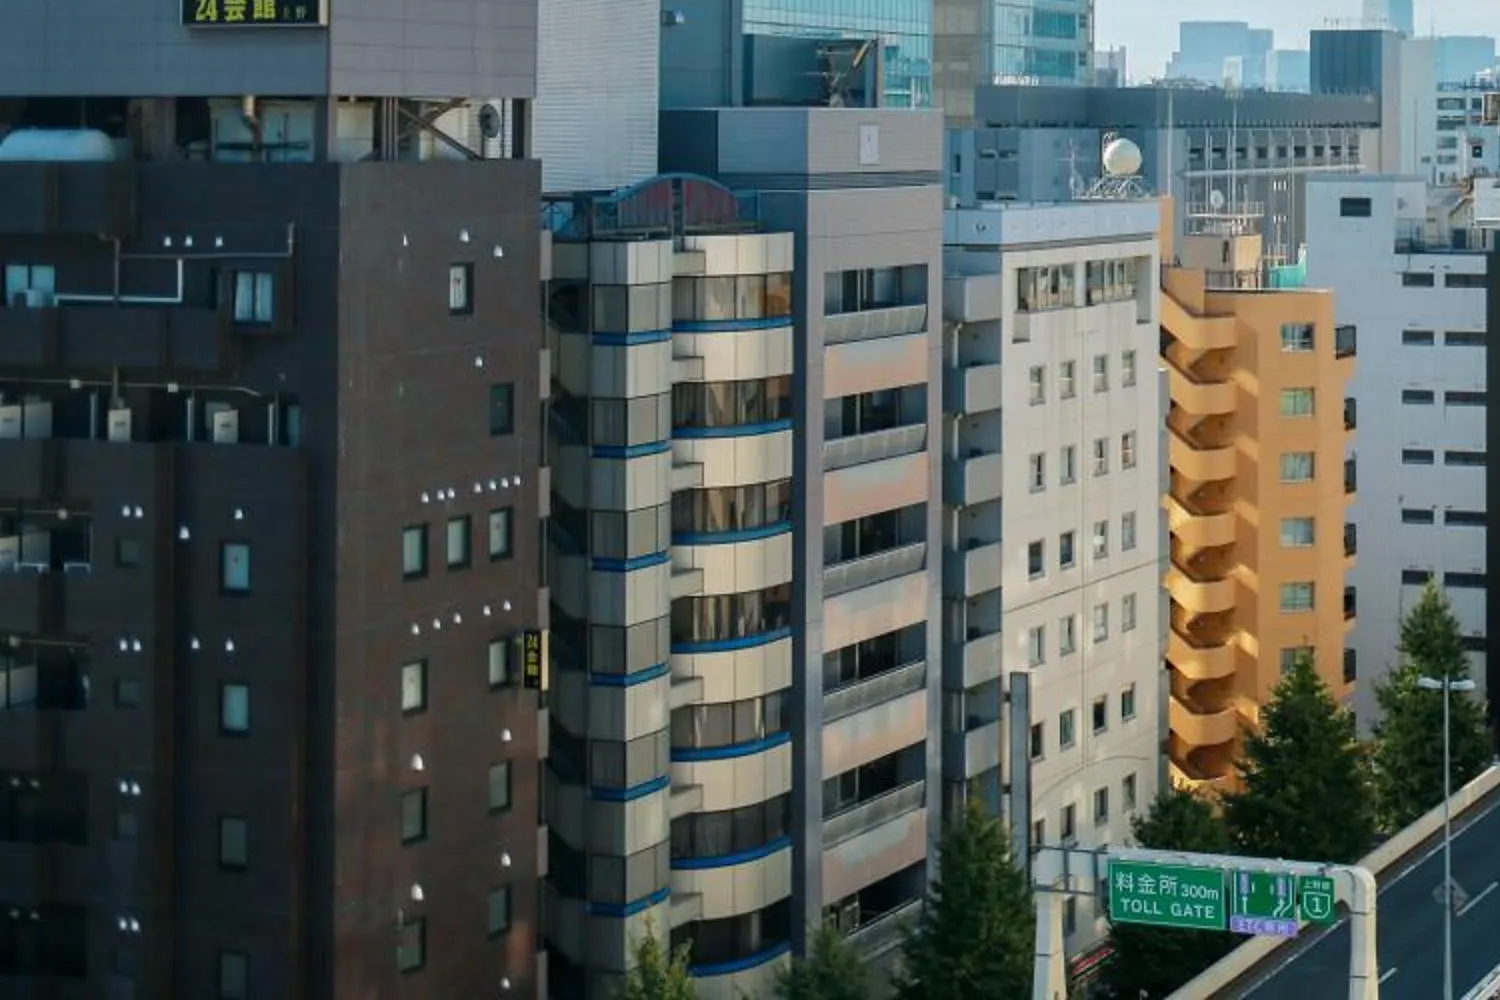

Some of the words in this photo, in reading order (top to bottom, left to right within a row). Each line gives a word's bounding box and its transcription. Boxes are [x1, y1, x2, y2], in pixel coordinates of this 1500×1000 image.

[1115, 871, 1178, 896] 料金所
[1181, 883, 1219, 900] 300m
[1121, 898, 1162, 916] TOLL
[1170, 903, 1216, 919] GATE
[1312, 897, 1322, 913] 1
